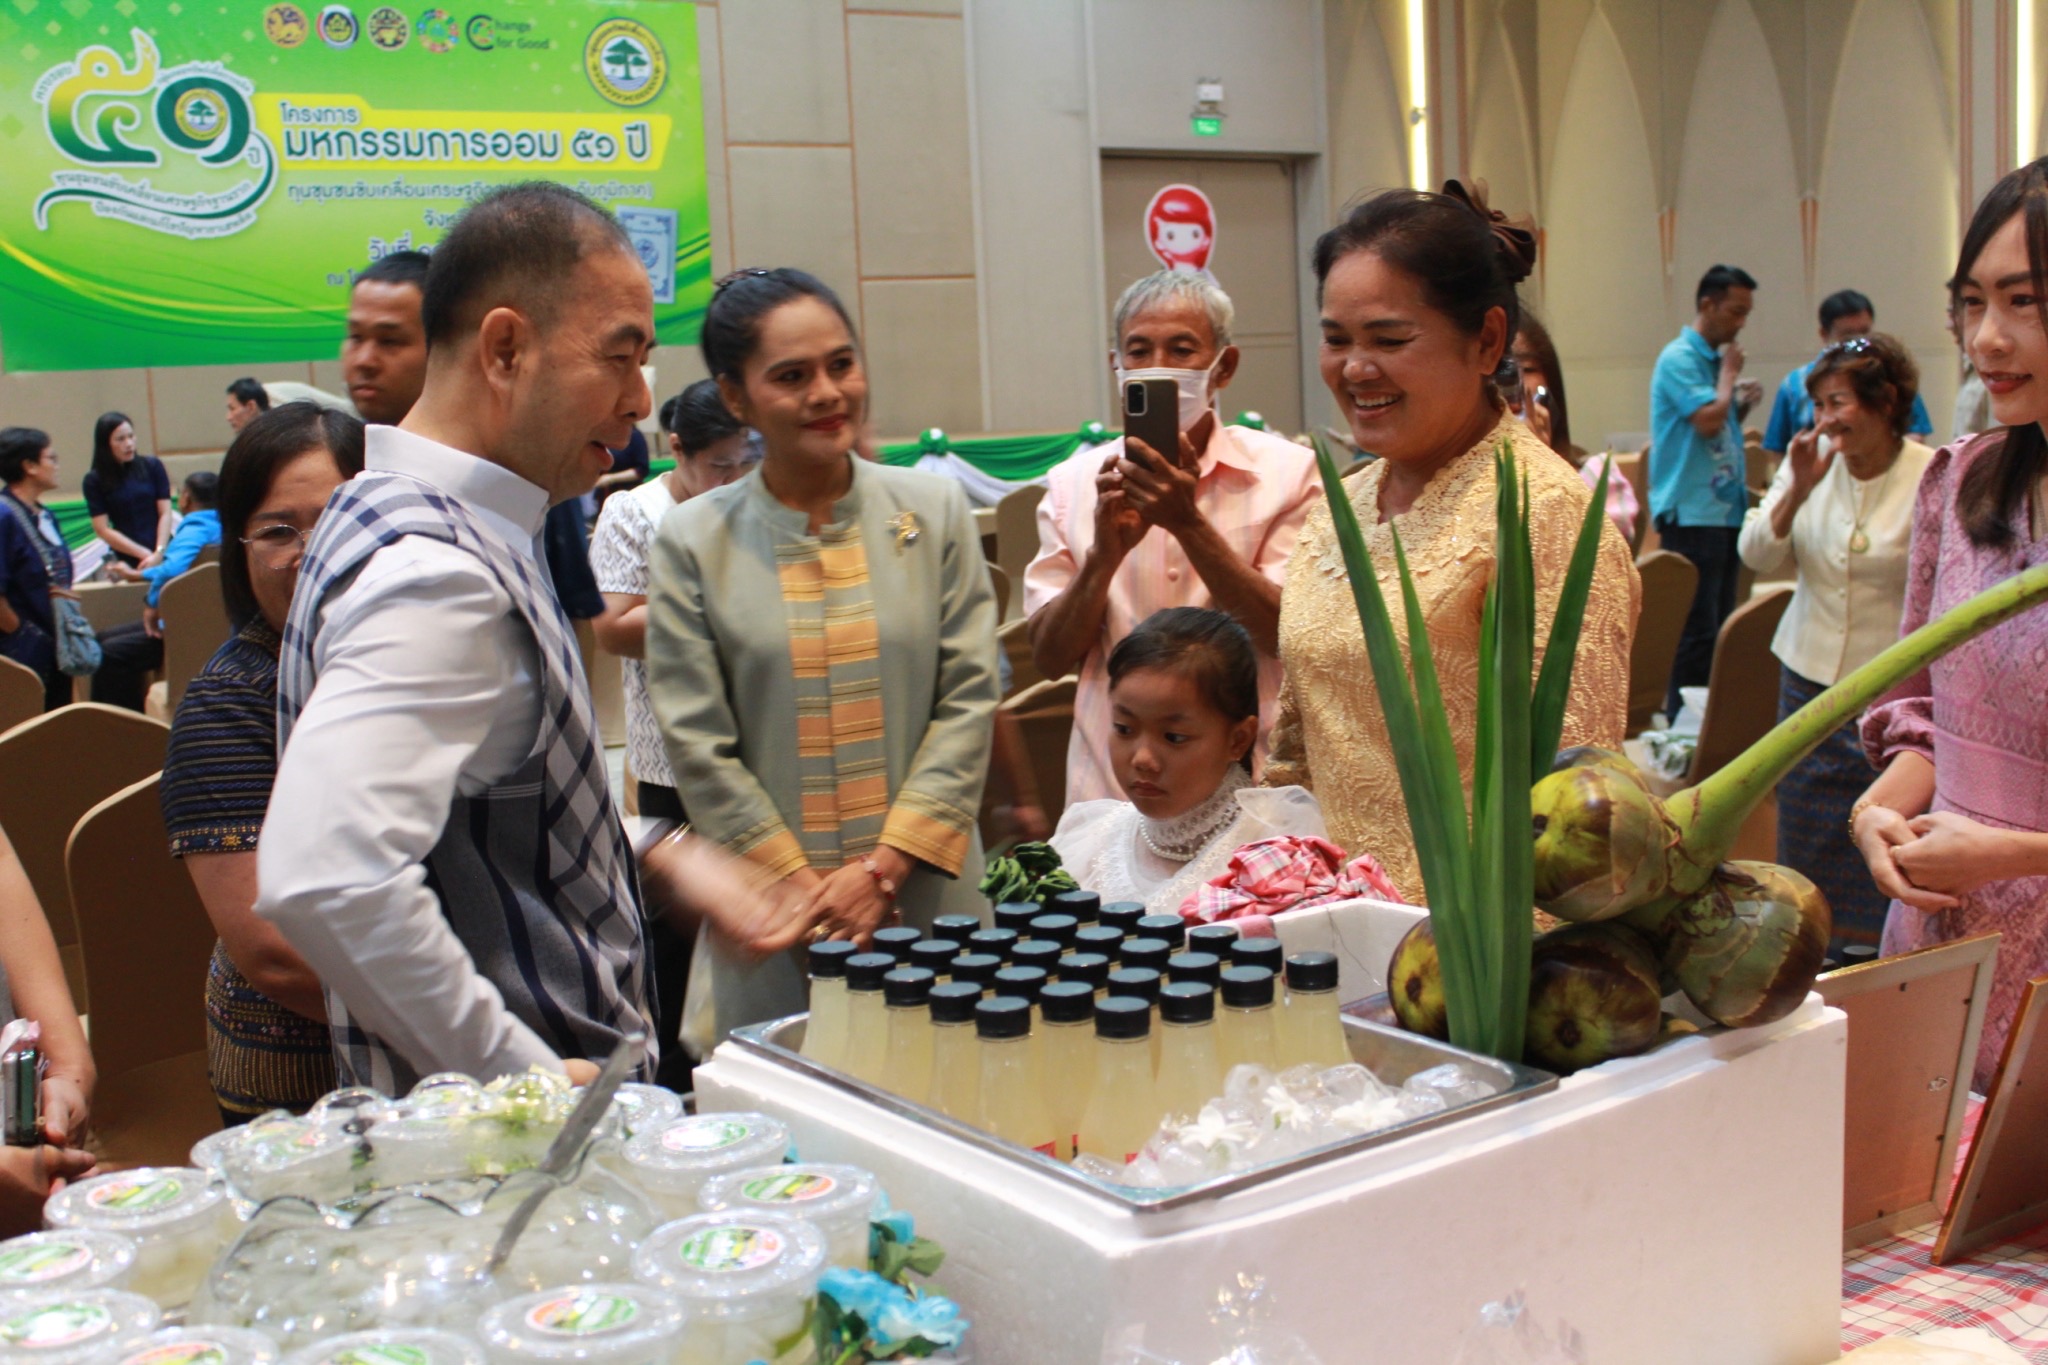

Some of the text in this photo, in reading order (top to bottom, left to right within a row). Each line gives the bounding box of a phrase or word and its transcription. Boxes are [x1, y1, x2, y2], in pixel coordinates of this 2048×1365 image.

[516, 37, 550, 49] Good
[281, 103, 358, 124] โครงการ
[285, 123, 646, 158] มหกรรมการออม ๕๑ ปี
